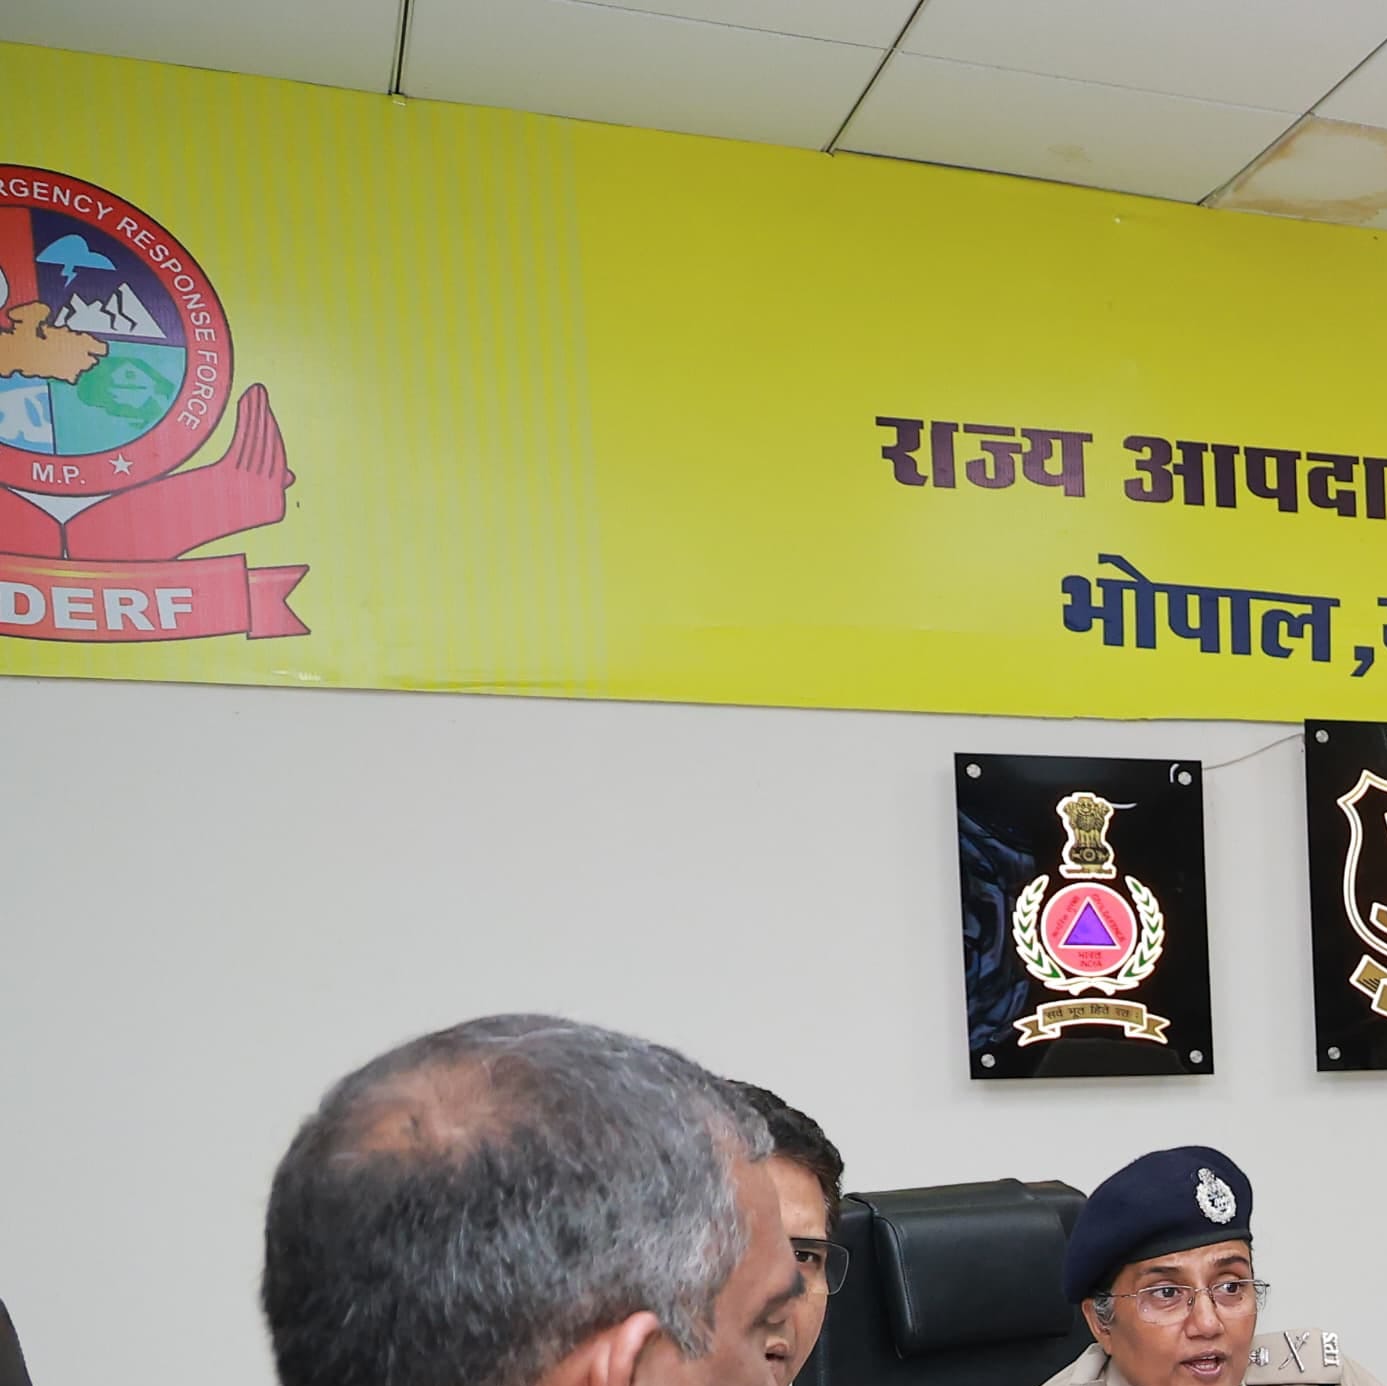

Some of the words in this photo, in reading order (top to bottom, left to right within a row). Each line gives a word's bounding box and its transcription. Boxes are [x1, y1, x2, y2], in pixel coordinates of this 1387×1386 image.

[116, 216, 216, 342] RESPONSE
[177, 350, 218, 431] FORCE
[32, 462, 87, 485] M.P.
[875, 416, 1093, 498] राज्य
[1322, 1331, 1340, 1367] IPS
